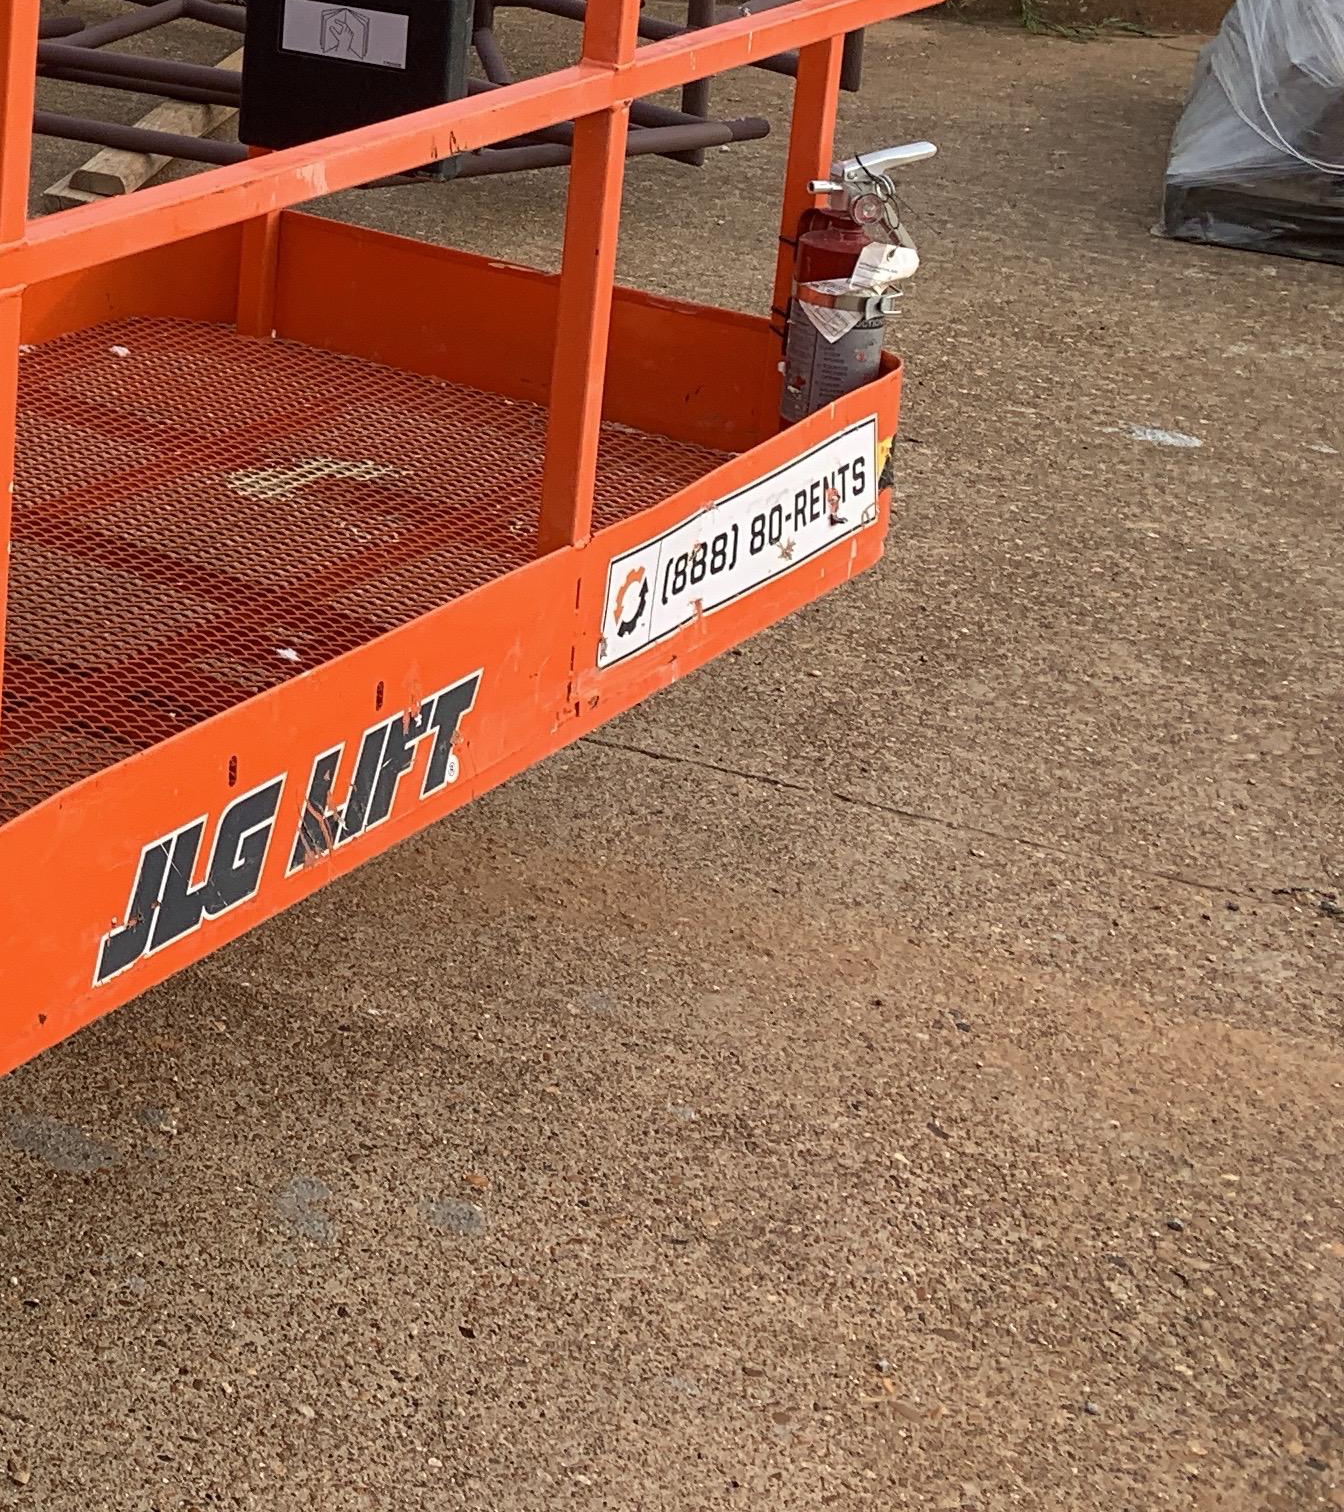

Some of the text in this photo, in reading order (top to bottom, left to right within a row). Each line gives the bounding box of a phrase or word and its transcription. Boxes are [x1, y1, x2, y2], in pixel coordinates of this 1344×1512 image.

[660, 456, 867, 607] (888) 80-RENTS
[93, 668, 485, 986] JLG LIFT
